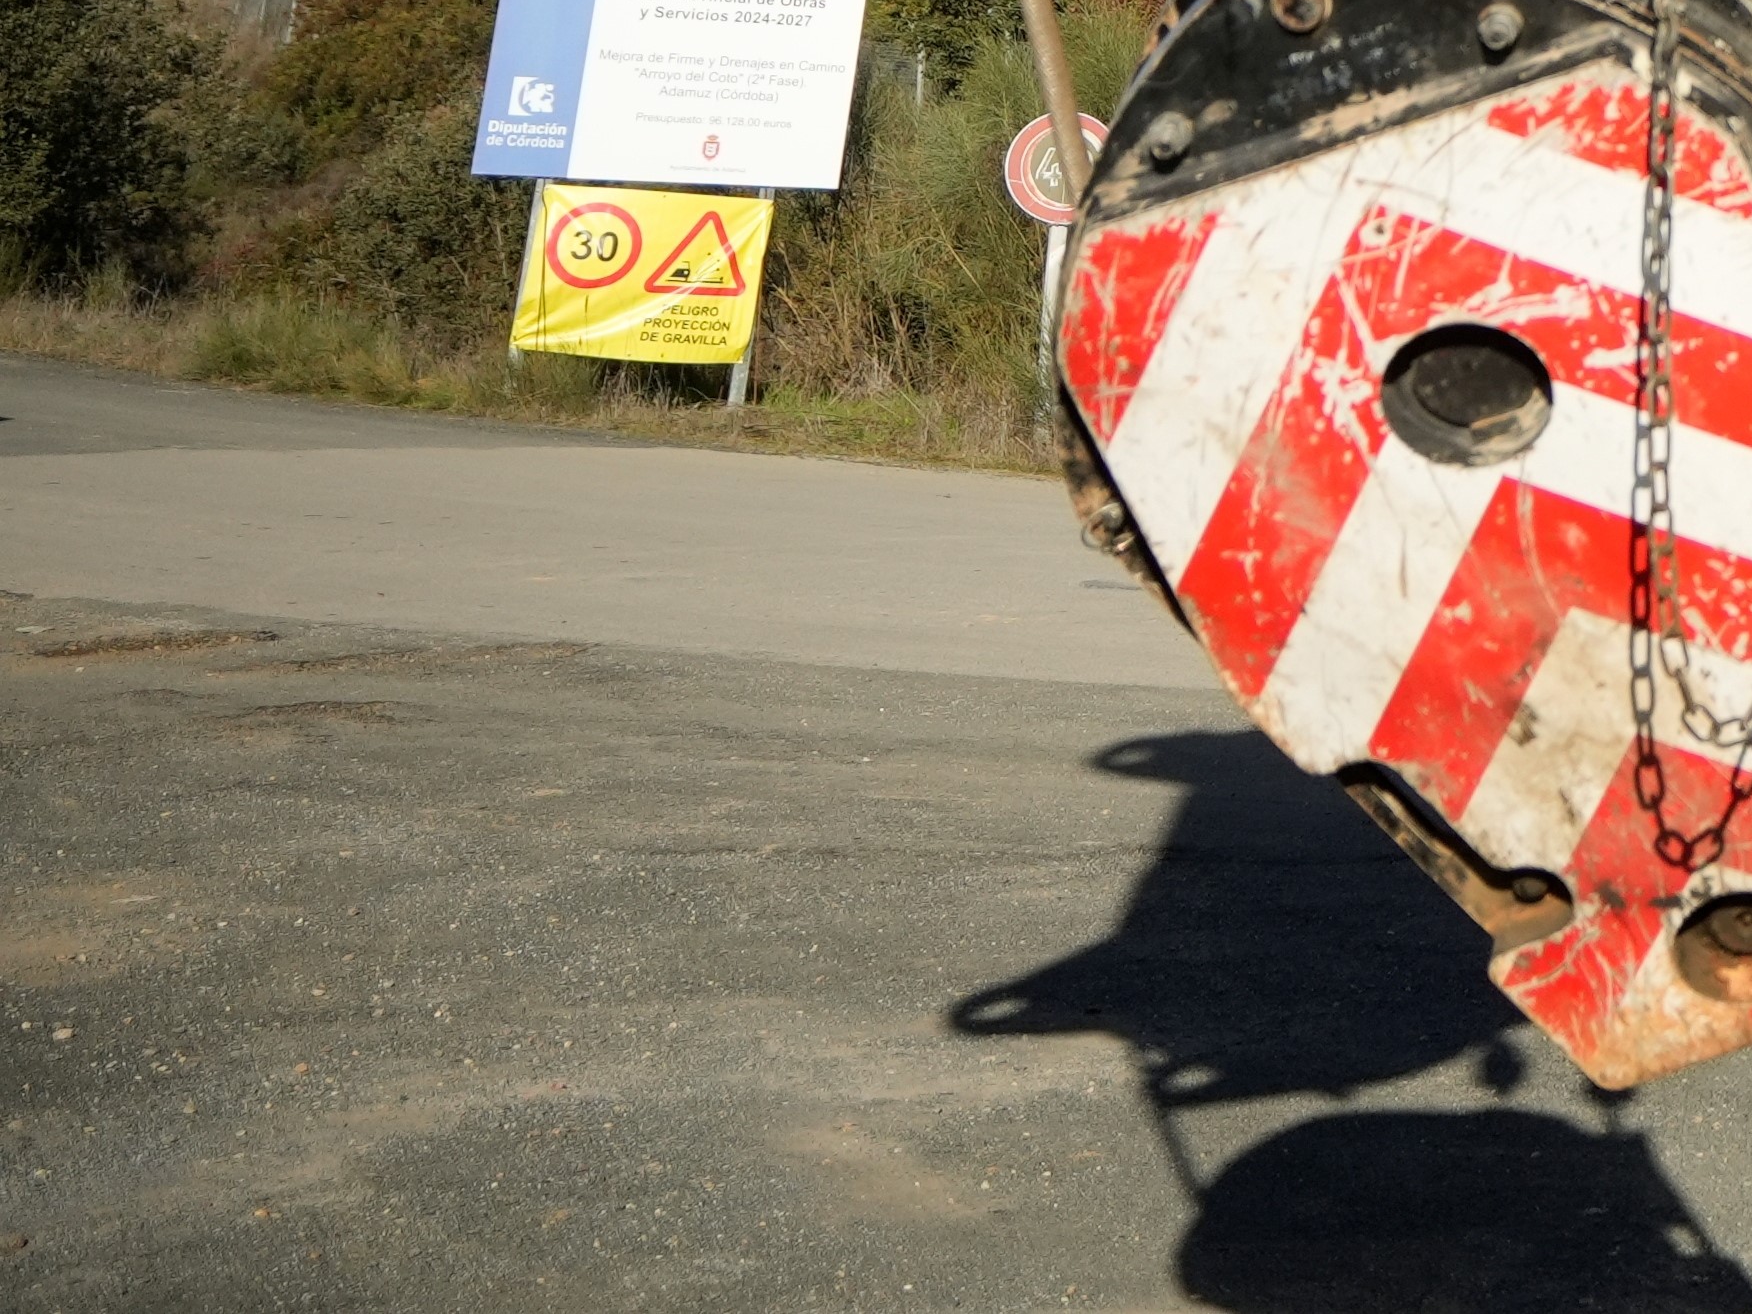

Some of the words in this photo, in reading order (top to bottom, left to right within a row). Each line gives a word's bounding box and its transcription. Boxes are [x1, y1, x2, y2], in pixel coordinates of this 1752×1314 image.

[639, 9, 649, 20] y
[654, 5, 729, 23] Servicios
[734, 10, 814, 28] 2024-2027
[599, 48, 644, 65] Mejora
[647, 50, 664, 64] de
[668, 52, 705, 67] Firme
[708, 57, 716, 68] y
[719, 55, 776, 72] Drenajes
[779, 60, 795, 71] en
[798, 60, 847, 74] Camino
[633, 66, 683, 83] "Arroyo
[685, 68, 704, 82] del
[707, 70, 745, 85] Coto"
[658, 84, 712, 100] Adamuz
[715, 86, 780, 104] (Córdoba)
[487, 118, 568, 138] Diputación
[763, 118, 792, 130] euros
[486, 134, 504, 147] de
[506, 133, 565, 150] Córdoba
[570, 229, 619, 262] 30
[661, 303, 720, 317] PELIGRO
[643, 316, 731, 332] PROYECCIÓN
[639, 331, 661, 343] DE
[662, 333, 728, 346] GRAVILLA
